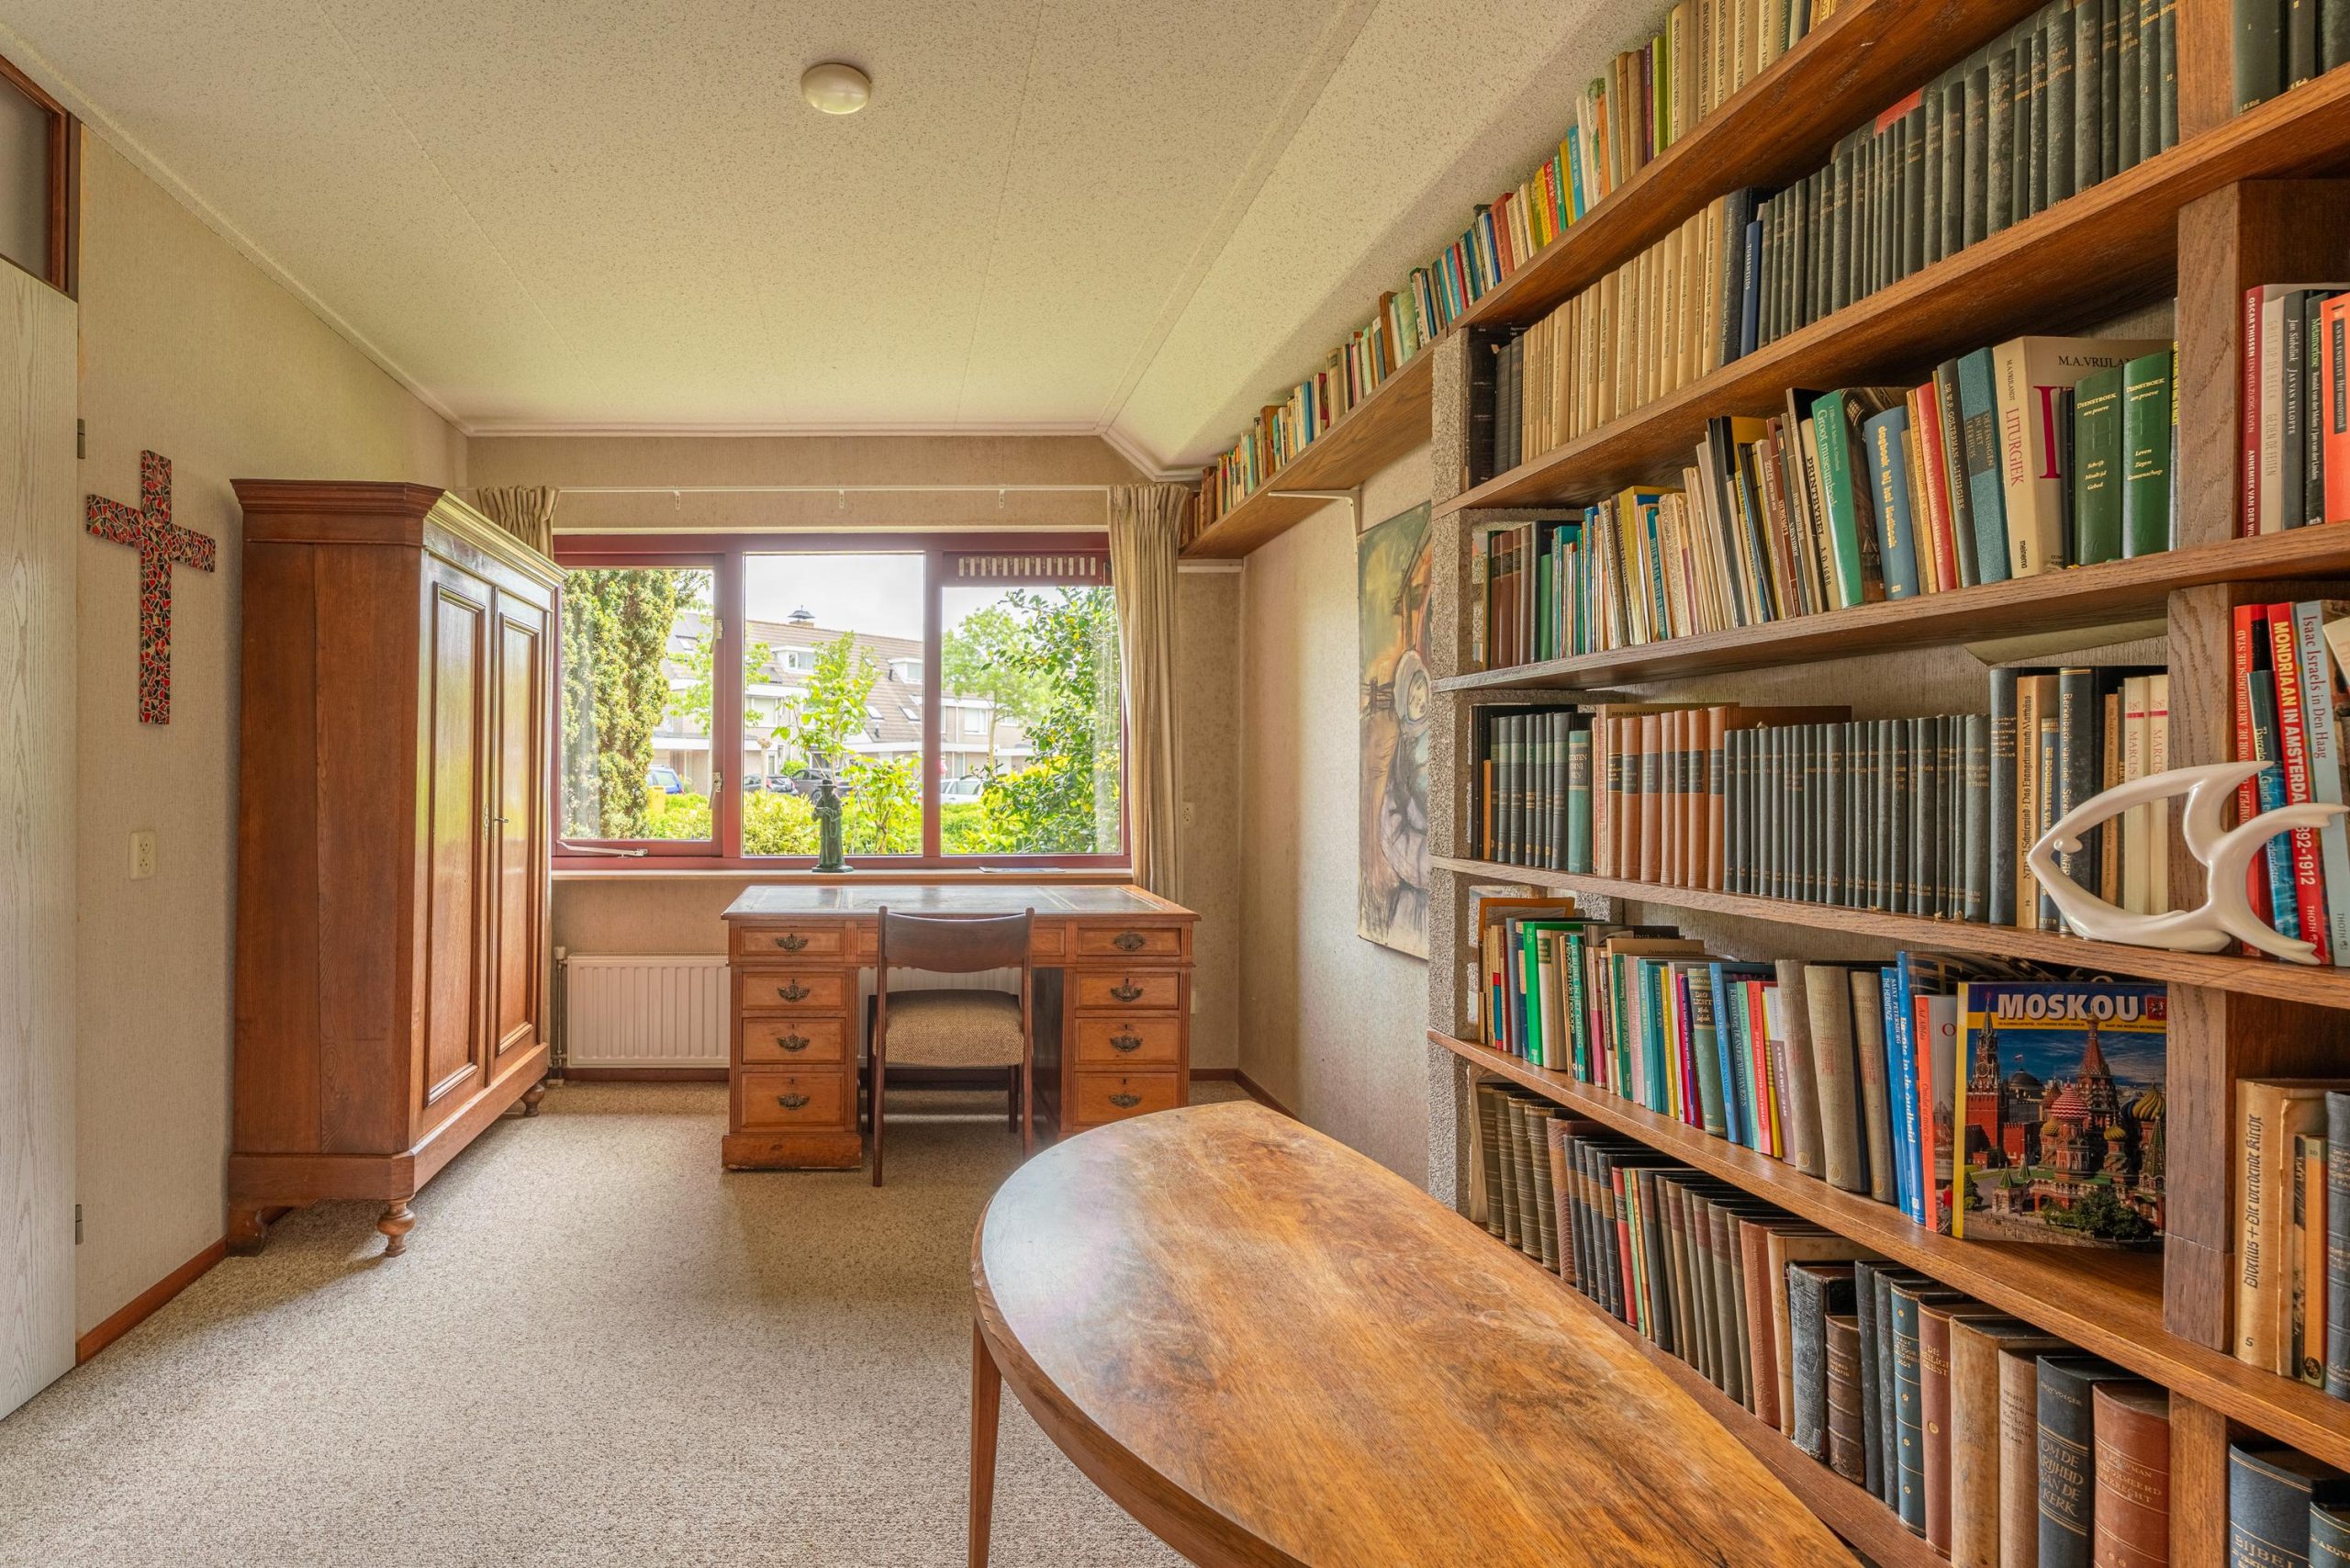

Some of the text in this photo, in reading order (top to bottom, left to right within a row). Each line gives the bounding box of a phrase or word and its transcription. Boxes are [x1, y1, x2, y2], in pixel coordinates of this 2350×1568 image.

[2311, 317, 2321, 367] Metamorfose
[2334, 324, 2343, 344] ANNA
[2335, 345, 2344, 377] ENQUIST
[2126, 377, 2165, 393] DIENSTBOEK
[2288, 319, 2298, 434] Jan Siebelink JAS VAN BELOFTE
[2311, 371, 2320, 390] Ronald
[2335, 379, 2344, 390] Het
[2076, 393, 2117, 409] DIENSTBOEK
[2139, 390, 2159, 400] proeve
[2311, 391, 2320, 399] van
[1975, 417, 1981, 427] IN
[2091, 405, 2109, 415] proeve
[2266, 413, 2277, 439] GEZIEN
[2310, 431, 2319, 441] Jan
[1876, 425, 1889, 467] dagboek
[1966, 420, 1975, 459] LEERHUIS
[1984, 412, 1995, 466] OEFENINGEN
[2003, 408, 2026, 486] LITURGIEK
[2266, 441, 2277, 452] DE
[2310, 442, 2319, 450] van
[1816, 409, 1836, 508] Groot museumboek
[1947, 410, 1964, 510] GOLTERMAN LITURGIEK
[2087, 459, 2105, 469] Schrift
[2134, 448, 2152, 456] Leven
[2134, 460, 2153, 468] Zegen
[2265, 453, 2277, 476] FEITEN
[1881, 468, 1892, 485] bij
[2085, 470, 2107, 480] Maaltijd
[2127, 469, 2163, 481] Gemeenschap
[2310, 460, 2318, 479] Linden
[1883, 486, 1894, 503] het
[2087, 481, 2104, 490] Gebed
[2308, 517, 2322, 526] ark
[2019, 540, 2027, 569] meinema
[2237, 630, 2247, 651] STAD
[2236, 652, 2248, 725] ARCHEOLOGISCHE
[2301, 615, 2329, 759] Isaac Israels in Den Haag
[2022, 695, 2031, 729] Matthäus
[2022, 731, 2031, 745] nach
[2063, 693, 2071, 782] Berkelbach van der
[2237, 727, 2248, 739] DE
[2255, 727, 2268, 761] Barcelo
[2045, 746, 2052, 758] DE
[2126, 731, 2140, 775] MARCUS
[2150, 728, 2164, 774] MARCUS
[2272, 621, 2316, 886] MONDRIAAN IN AMSTERDA 892-1912
[2022, 746, 2031, 785] Evangelium
[2022, 788, 2031, 804] Das
[2022, 808, 2031, 847] Schniewind
[2266, 837, 2279, 887] odernisten
[2305, 904, 2317, 932] THOTH
[2336, 913, 2346, 938] THOTH
[1571, 944, 1577, 953] DE
[1571, 955, 1579, 982] BIJBEL
[1572, 984, 1580, 993] IN
[1883, 989, 1892, 1021] HERMITAGE
[1998, 993, 2139, 1021] MOSKOU
[1574, 1013, 1583, 1047] GEDING
[1892, 1002, 1901, 1044] PETERSBURG
[1917, 1006, 1928, 1040] Ad Alblas
[1902, 1058, 1910, 1071] in
[1903, 1074, 1911, 1089] de
[1920, 1083, 1929, 1107] Omdat
[1904, 1092, 1915, 1143] oudheid
[1922, 1107, 1930, 1115] er
[2243, 1114, 2263, 1287] Dibelius Die werdende Kirche
[1927, 1344, 1940, 1357] DE
[2041, 1439, 2080, 1469] OM DE
[2109, 1454, 2153, 1479] BOUWMAN
[2040, 1472, 2082, 1502] VAN DE
[2042, 1488, 2078, 1518] KERK
